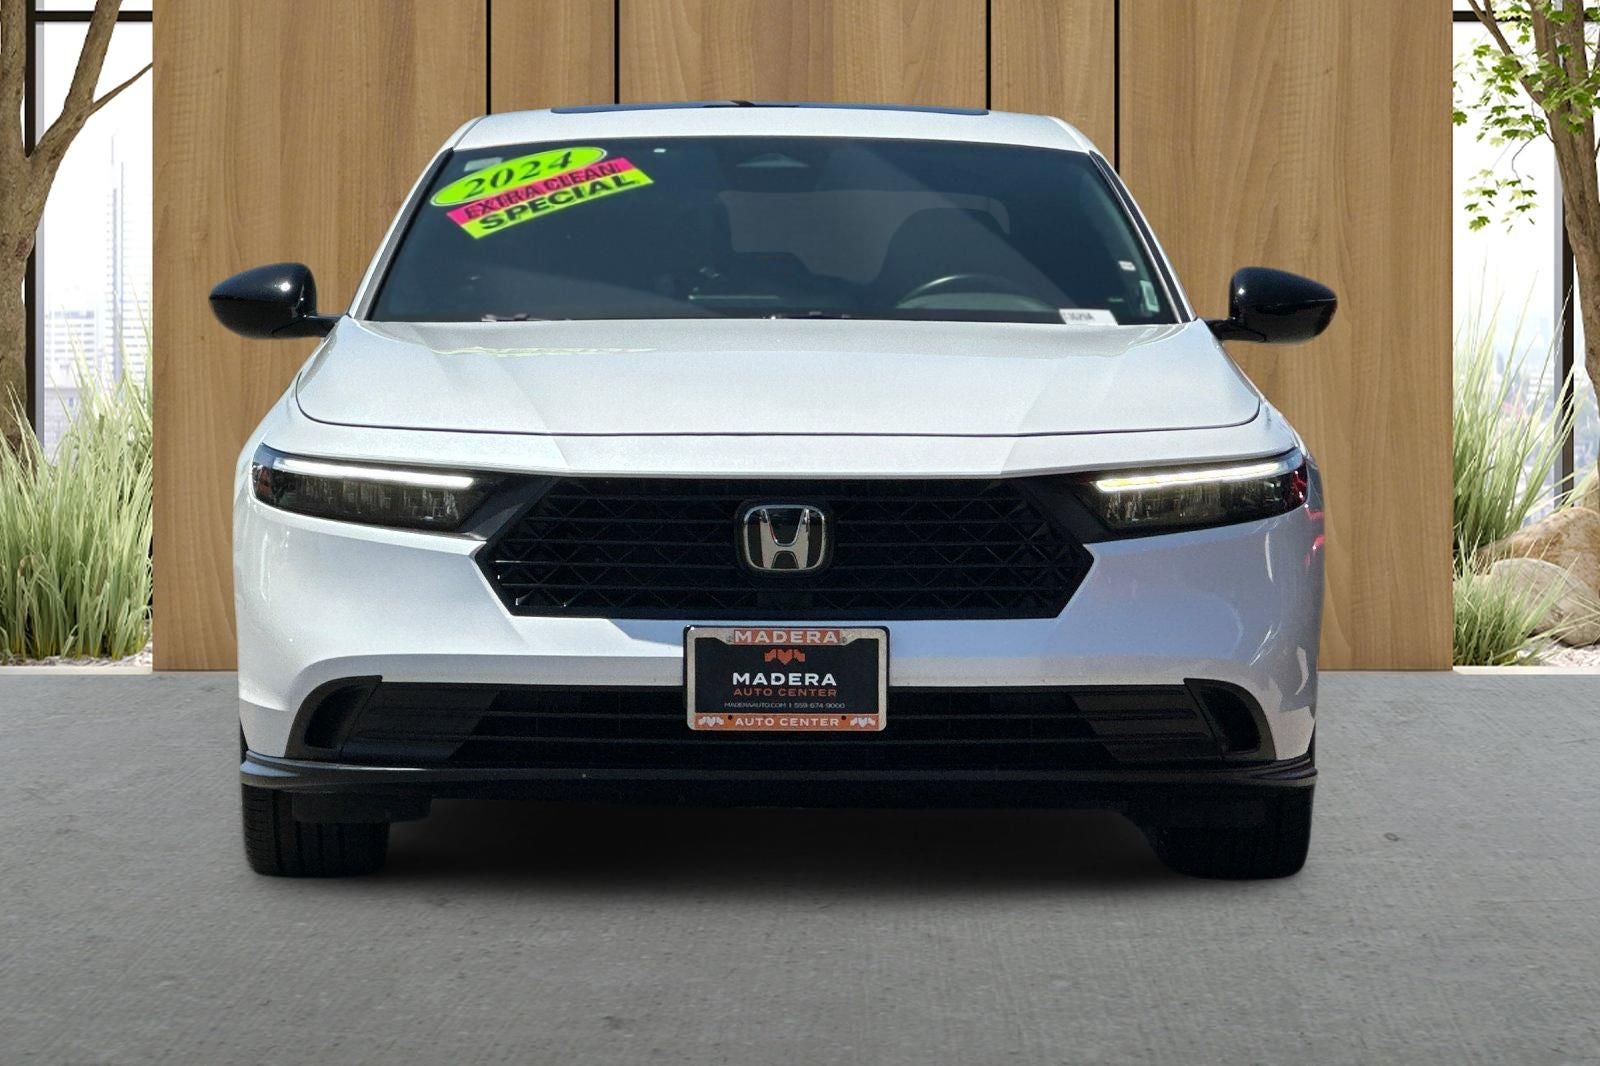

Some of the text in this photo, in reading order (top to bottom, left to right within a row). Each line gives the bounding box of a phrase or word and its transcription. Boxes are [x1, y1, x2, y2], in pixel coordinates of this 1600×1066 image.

[463, 151, 572, 199] 2024
[464, 184, 540, 220] EXTRA
[478, 174, 637, 230] SPECIAL
[734, 630, 839, 643] MADERA
[732, 672, 837, 686] MADERA
[733, 688, 837, 697] AUTO CENTER
[735, 717, 840, 727] AUTO CENTER
